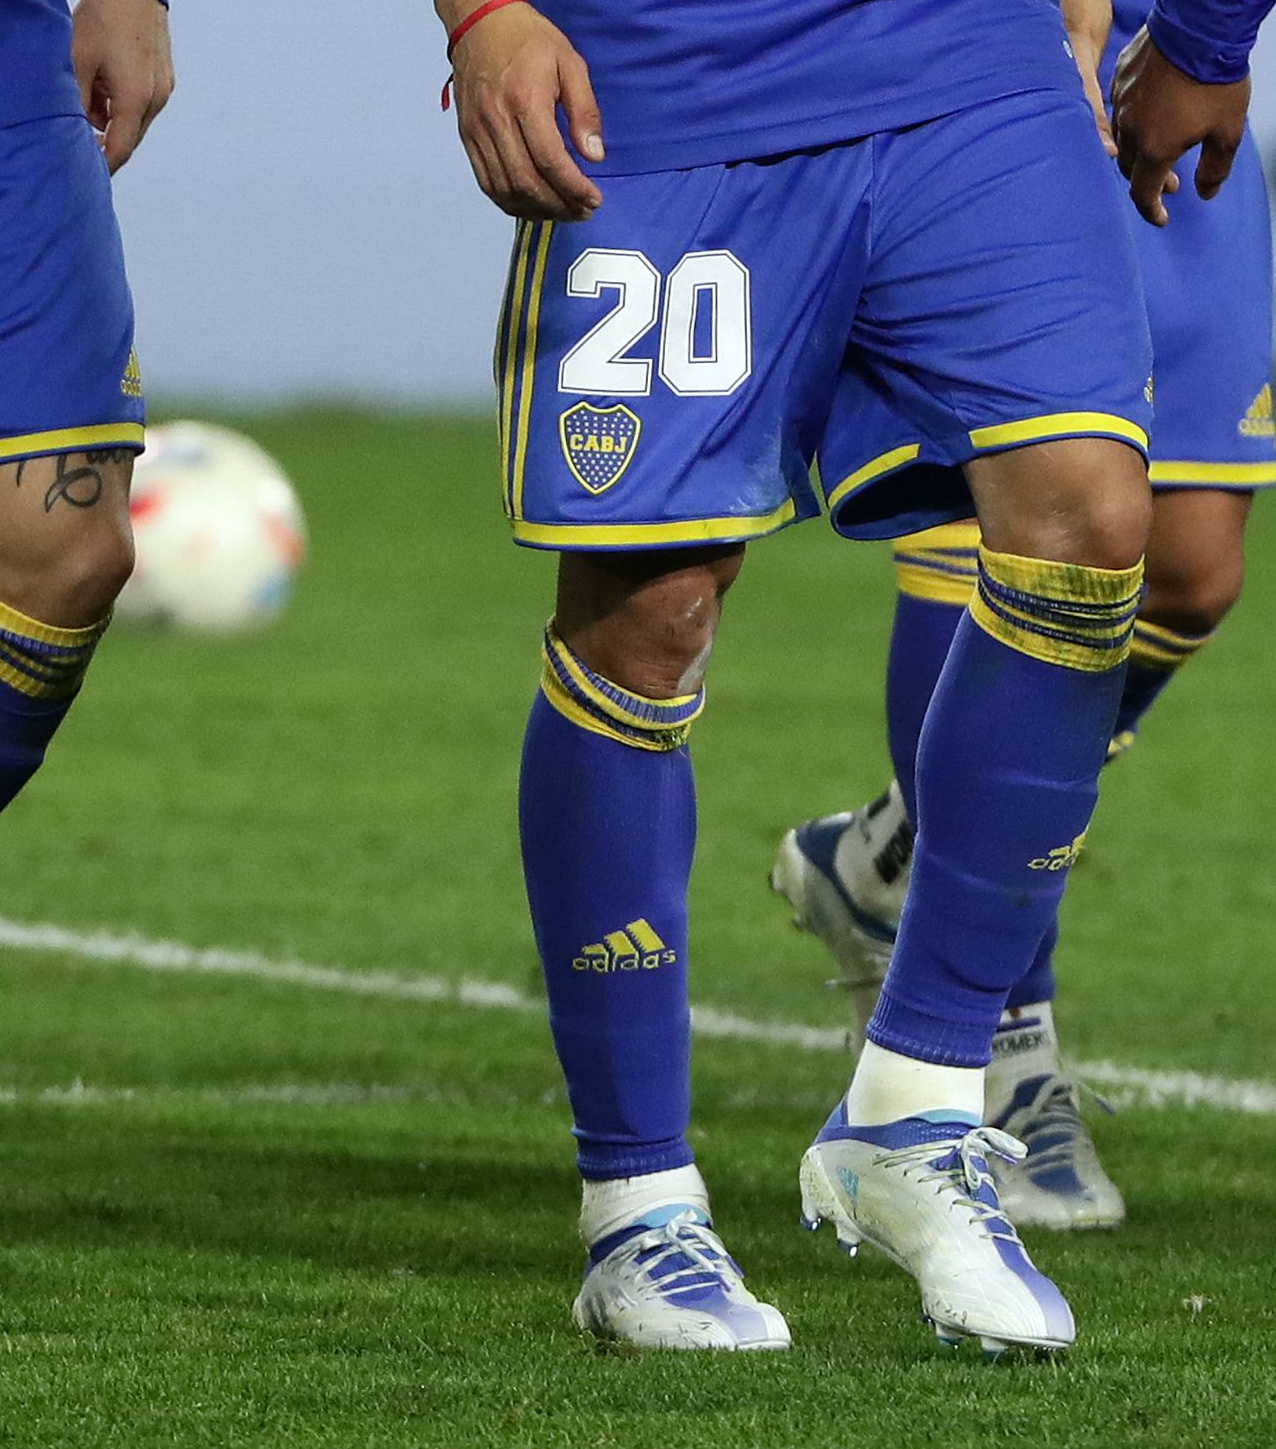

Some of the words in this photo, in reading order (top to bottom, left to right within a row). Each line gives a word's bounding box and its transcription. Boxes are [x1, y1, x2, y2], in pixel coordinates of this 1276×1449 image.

[557, 247, 751, 397] 20
[571, 436, 626, 453] CABJ
[572, 947, 677, 973] adidas
